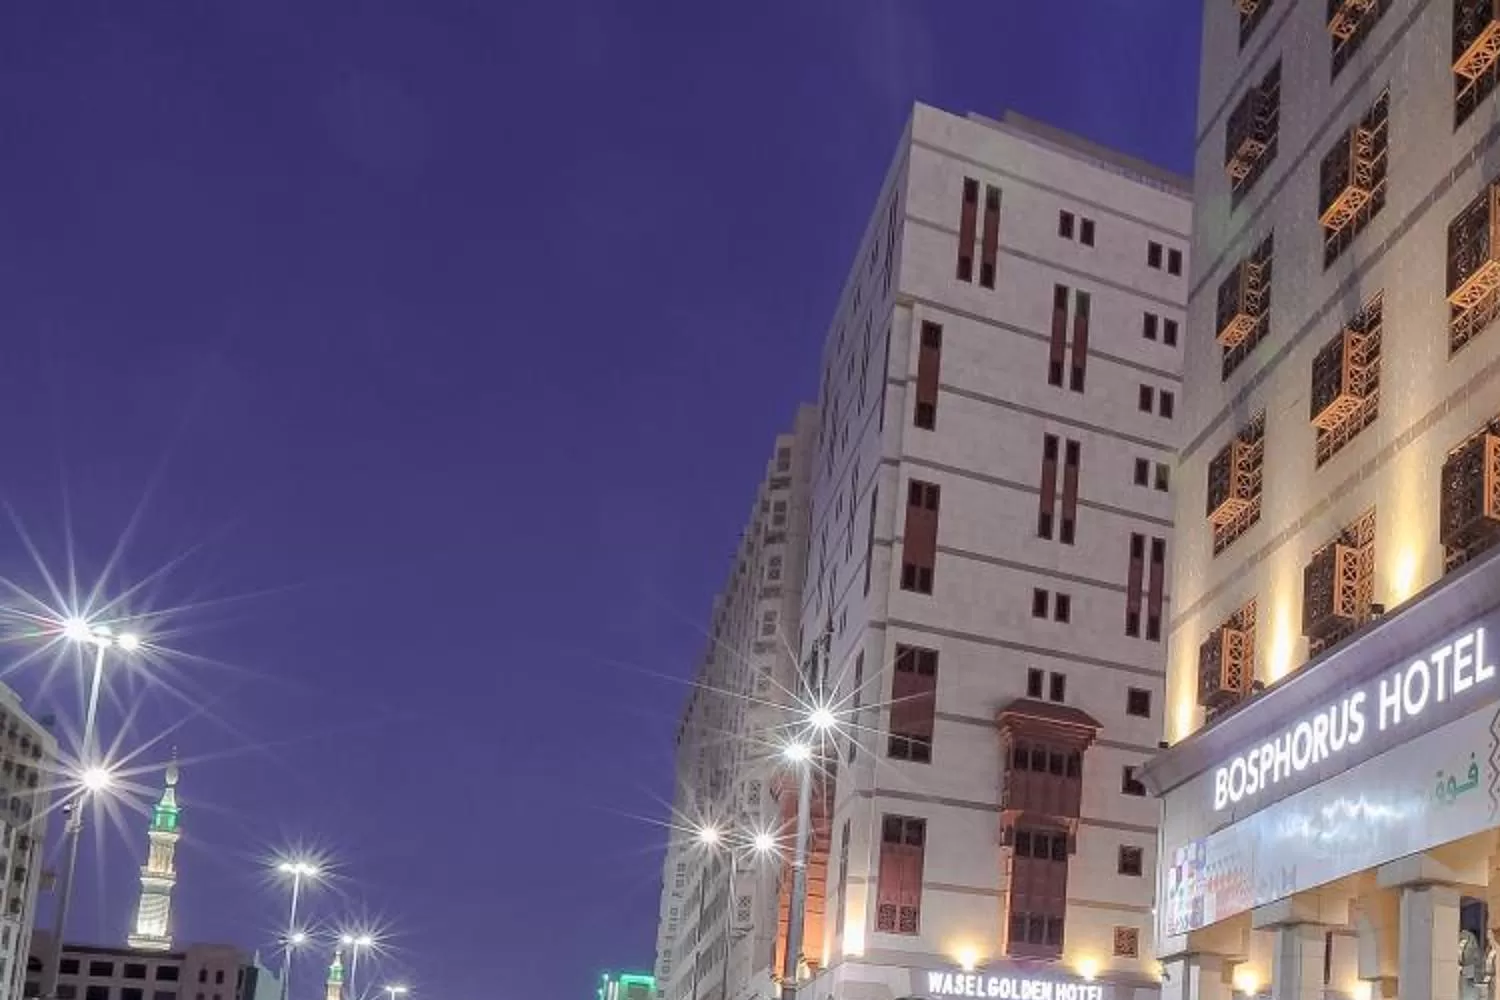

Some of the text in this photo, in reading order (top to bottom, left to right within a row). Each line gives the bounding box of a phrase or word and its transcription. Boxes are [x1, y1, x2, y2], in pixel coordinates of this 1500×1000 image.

[1213, 627, 1496, 811] BOSPHORUS HOTEL
[928, 971, 986, 998] WASEL
